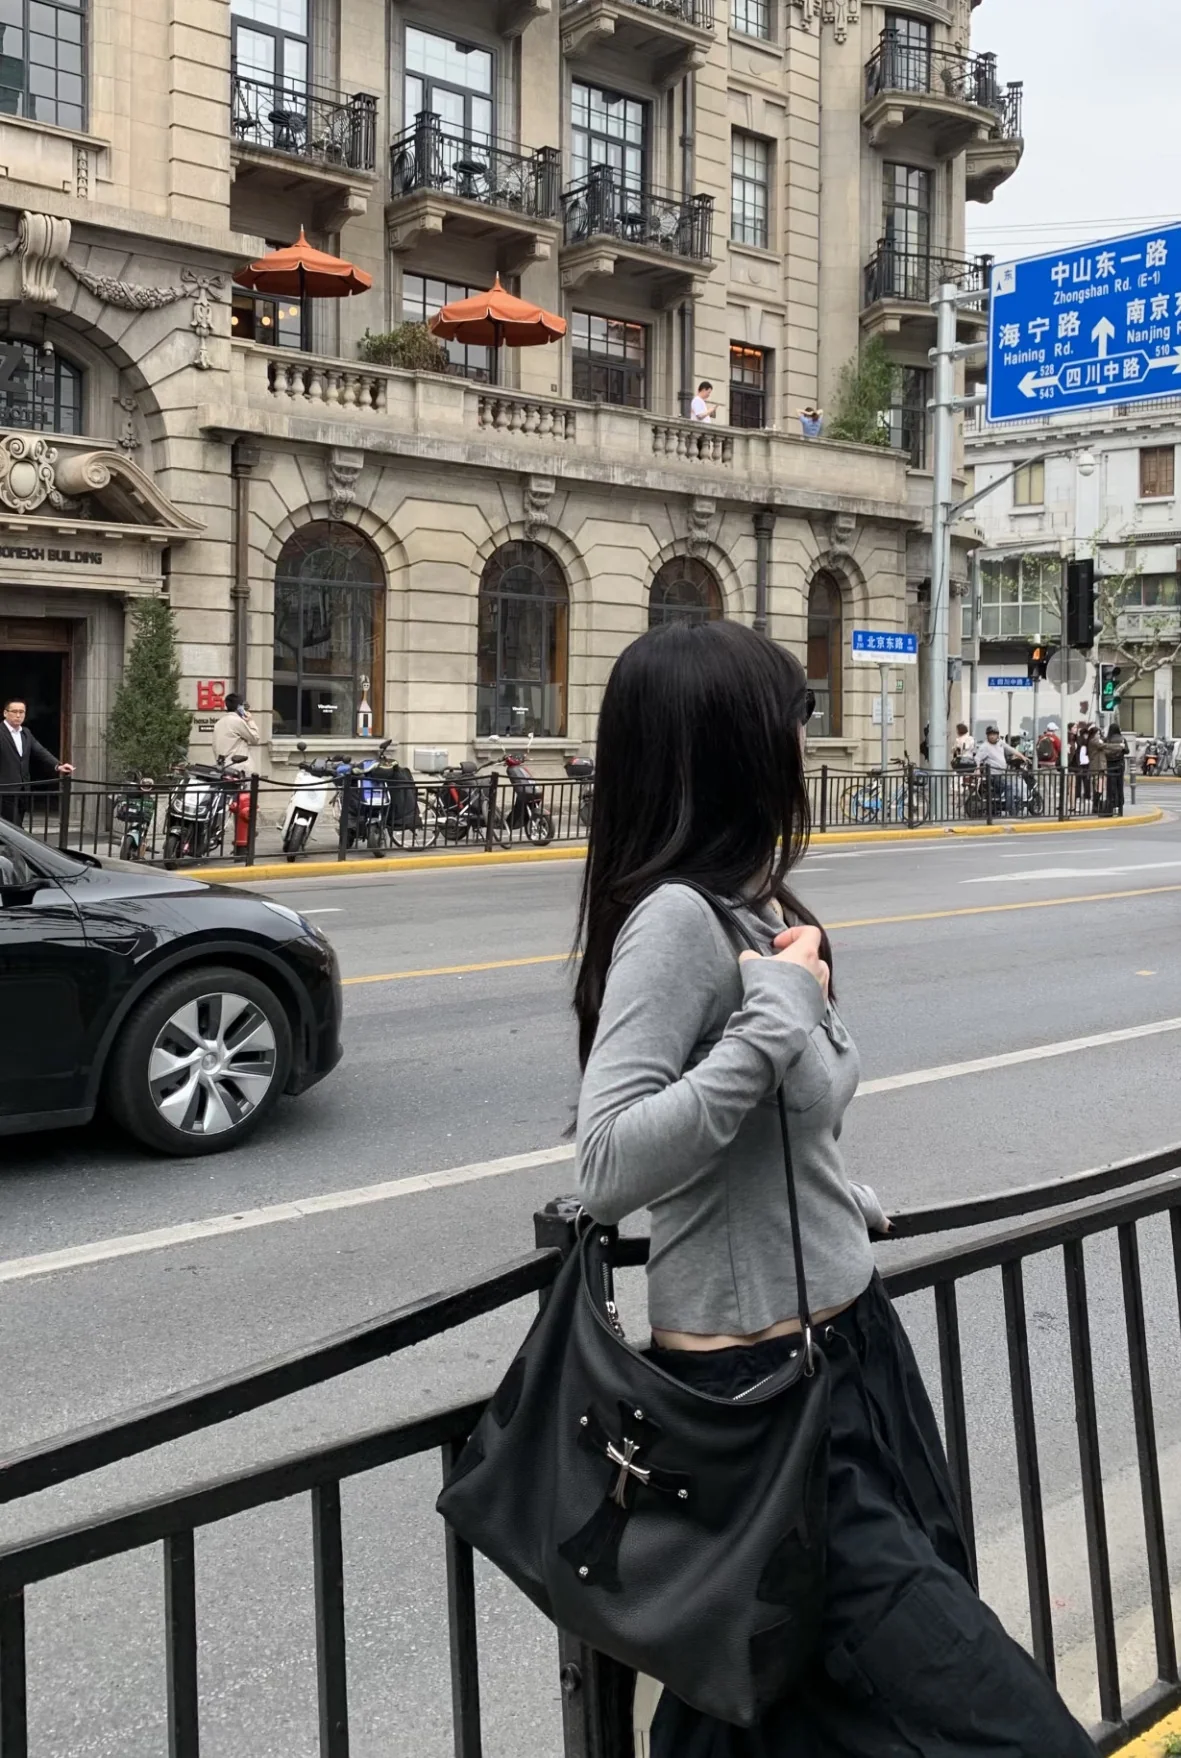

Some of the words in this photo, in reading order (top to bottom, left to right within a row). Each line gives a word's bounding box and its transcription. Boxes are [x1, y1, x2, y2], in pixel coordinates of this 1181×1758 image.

[1051, 238, 1168, 288] 中山东一路
[1004, 269, 1013, 282] 东
[1053, 283, 1109, 306] Zhongshan
[1114, 277, 1132, 293] Rd.
[1137, 270, 1161, 288] (E-1)
[998, 310, 1081, 350] 海宁路
[1126, 324, 1171, 344] Nanjing
[1003, 347, 1046, 367] Haining
[1054, 340, 1074, 357] Rd.
[1155, 343, 1170, 357] 510
[1040, 363, 1055, 377] 528
[1066, 356, 1140, 388] 四川中路
[1039, 387, 1055, 401] 543
[47, 548, 103, 565] BUILDING
[866, 635, 904, 650] 北京东路
